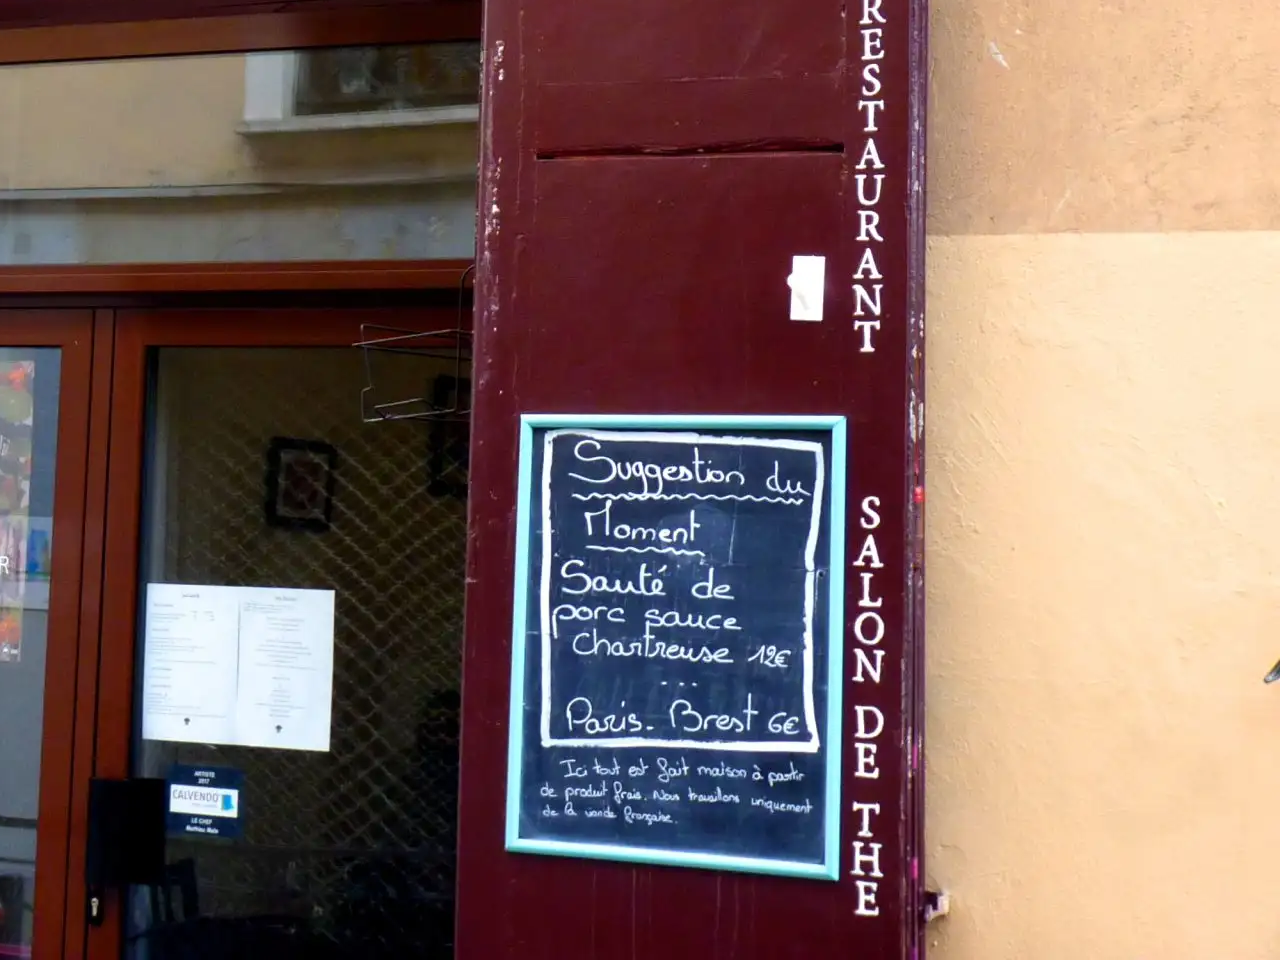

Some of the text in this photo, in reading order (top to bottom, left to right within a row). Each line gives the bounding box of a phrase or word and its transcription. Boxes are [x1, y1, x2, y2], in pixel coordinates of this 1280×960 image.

[568, 439, 812, 496] Suggestion du
[584, 499, 701, 543] Moment
[560, 559, 735, 600] Sauté de
[551, 603, 742, 640] porc sauce
[572, 627, 792, 669] Chartreuse 12€
[669, 693, 759, 733] Brest
[768, 712, 801, 735] 6€
[850, 496, 886, 917] SALON DE THE
[559, 757, 805, 789] Ici tout est fait maison à partir
[173, 788, 220, 803] CALVENDO
[540, 783, 559, 797] de
[564, 780, 608, 802] produit
[652, 789, 680, 801] Nous
[750, 797, 814, 814] uniquement
[542, 804, 560, 817] de
